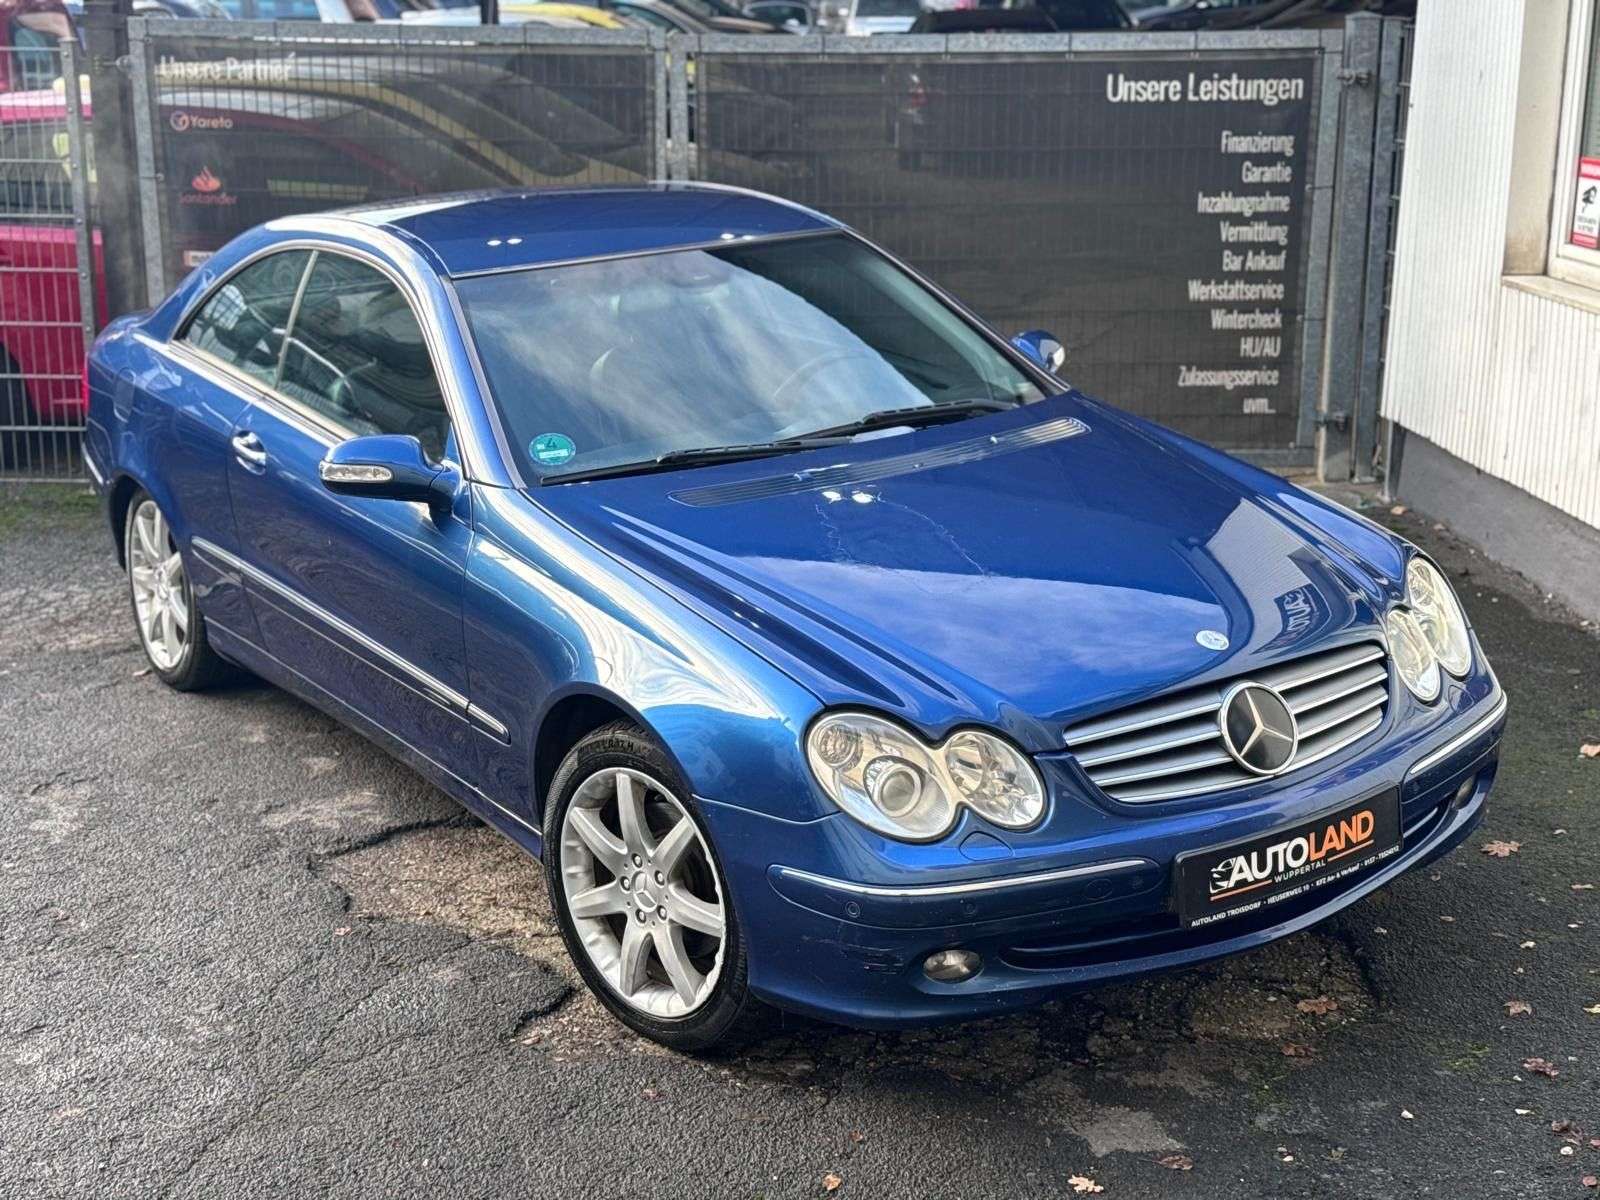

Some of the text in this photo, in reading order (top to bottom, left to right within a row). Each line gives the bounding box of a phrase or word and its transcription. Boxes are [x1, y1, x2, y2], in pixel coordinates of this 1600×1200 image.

[226, 56, 291, 80] Partner
[1106, 72, 1303, 105] Unsere Leistungen
[190, 114, 233, 129] Yareto
[1221, 130, 1294, 155] Finanzierung
[1242, 160, 1292, 183] Garantie
[1197, 191, 1290, 217] Inzahlungnahme
[1220, 220, 1288, 245] Vermittlung
[1222, 250, 1286, 272] Bar Ankauf
[1188, 279, 1284, 301] Werkstattservice
[1211, 308, 1282, 330] Wintercheck
[1240, 336, 1281, 357] HU/AU
[1177, 365, 1279, 390] Zulassungsservice
[1226, 810, 1375, 888] AUTOLAND
[1274, 860, 1326, 883] WUPPERTAL
[1191, 912, 1226, 927] AUTOLAND
[1227, 901, 1261, 917] TROISDORF
[1267, 887, 1302, 904] HEUSERWEG
